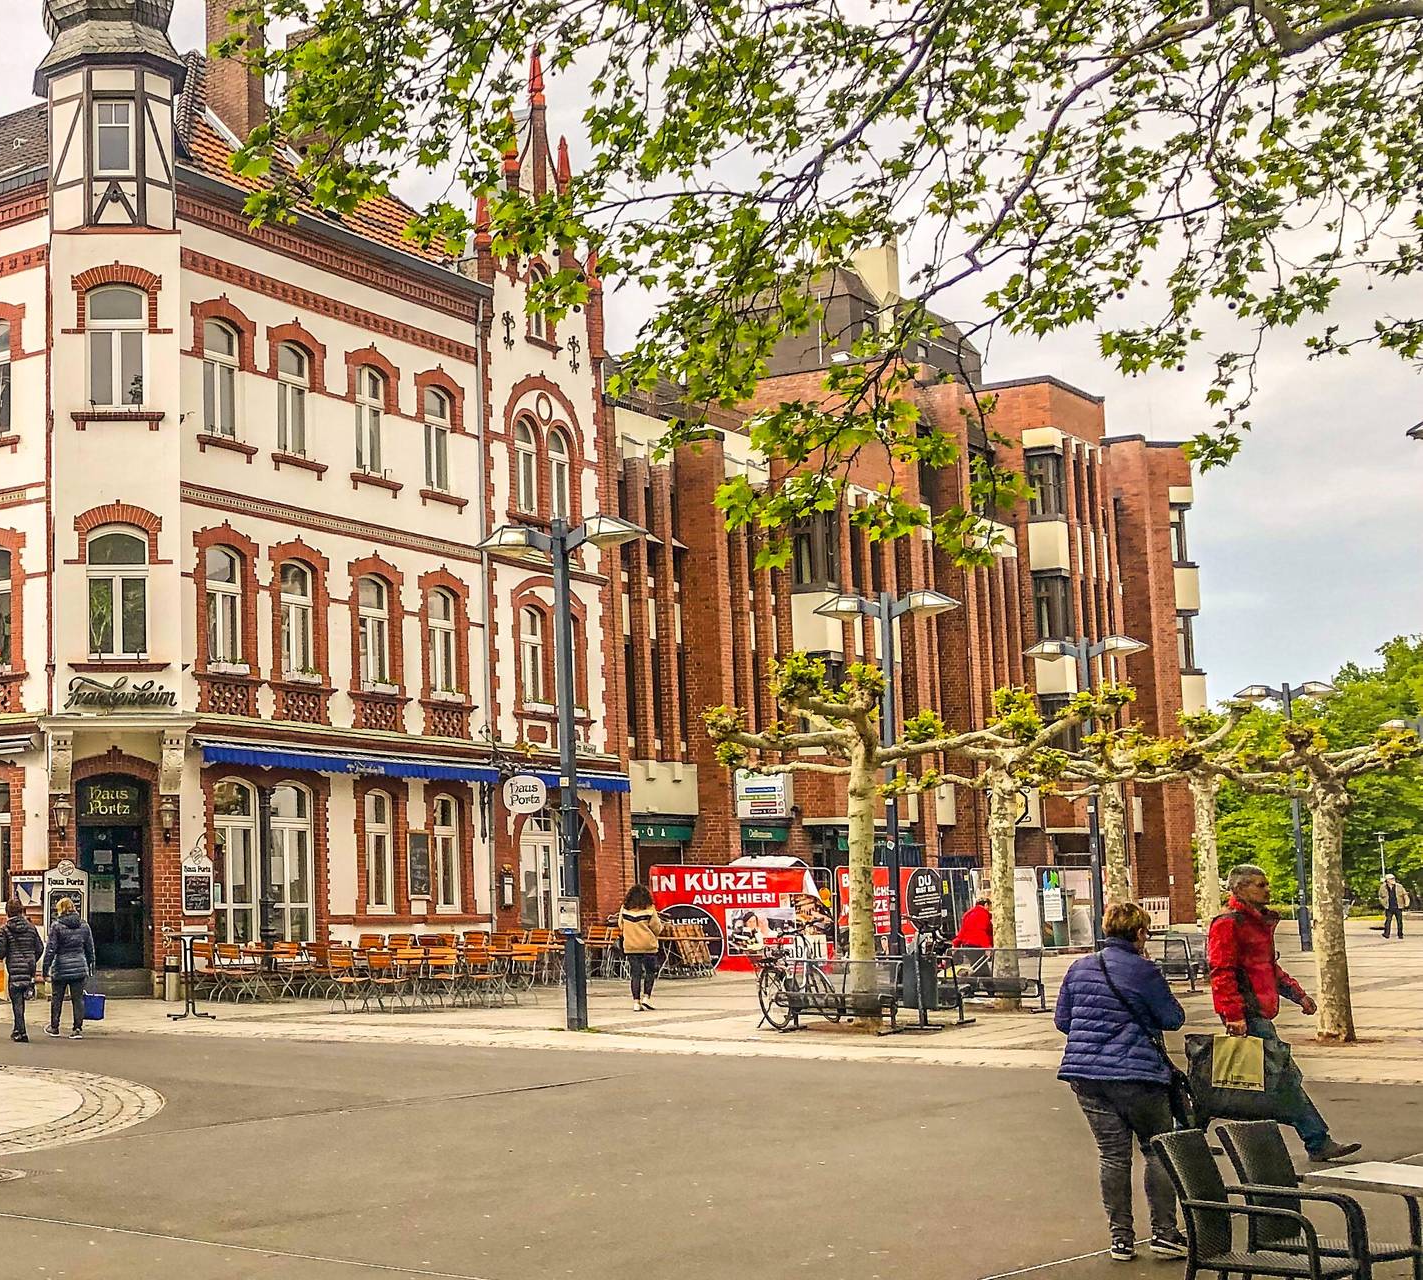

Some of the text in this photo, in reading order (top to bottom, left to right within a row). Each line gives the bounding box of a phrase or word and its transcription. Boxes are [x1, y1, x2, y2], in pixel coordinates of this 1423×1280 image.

[63, 675, 178, 712] Frankenheim
[89, 784, 129, 800] Haus
[509, 781, 539, 794] Haus
[89, 799, 131, 815] Portz
[509, 794, 541, 807] Portz
[47, 877, 84, 886] Haus Portz
[651, 869, 768, 892] IN KÜRZE
[918, 874, 932, 887] DU
[692, 892, 776, 905] AUCH HIER!
